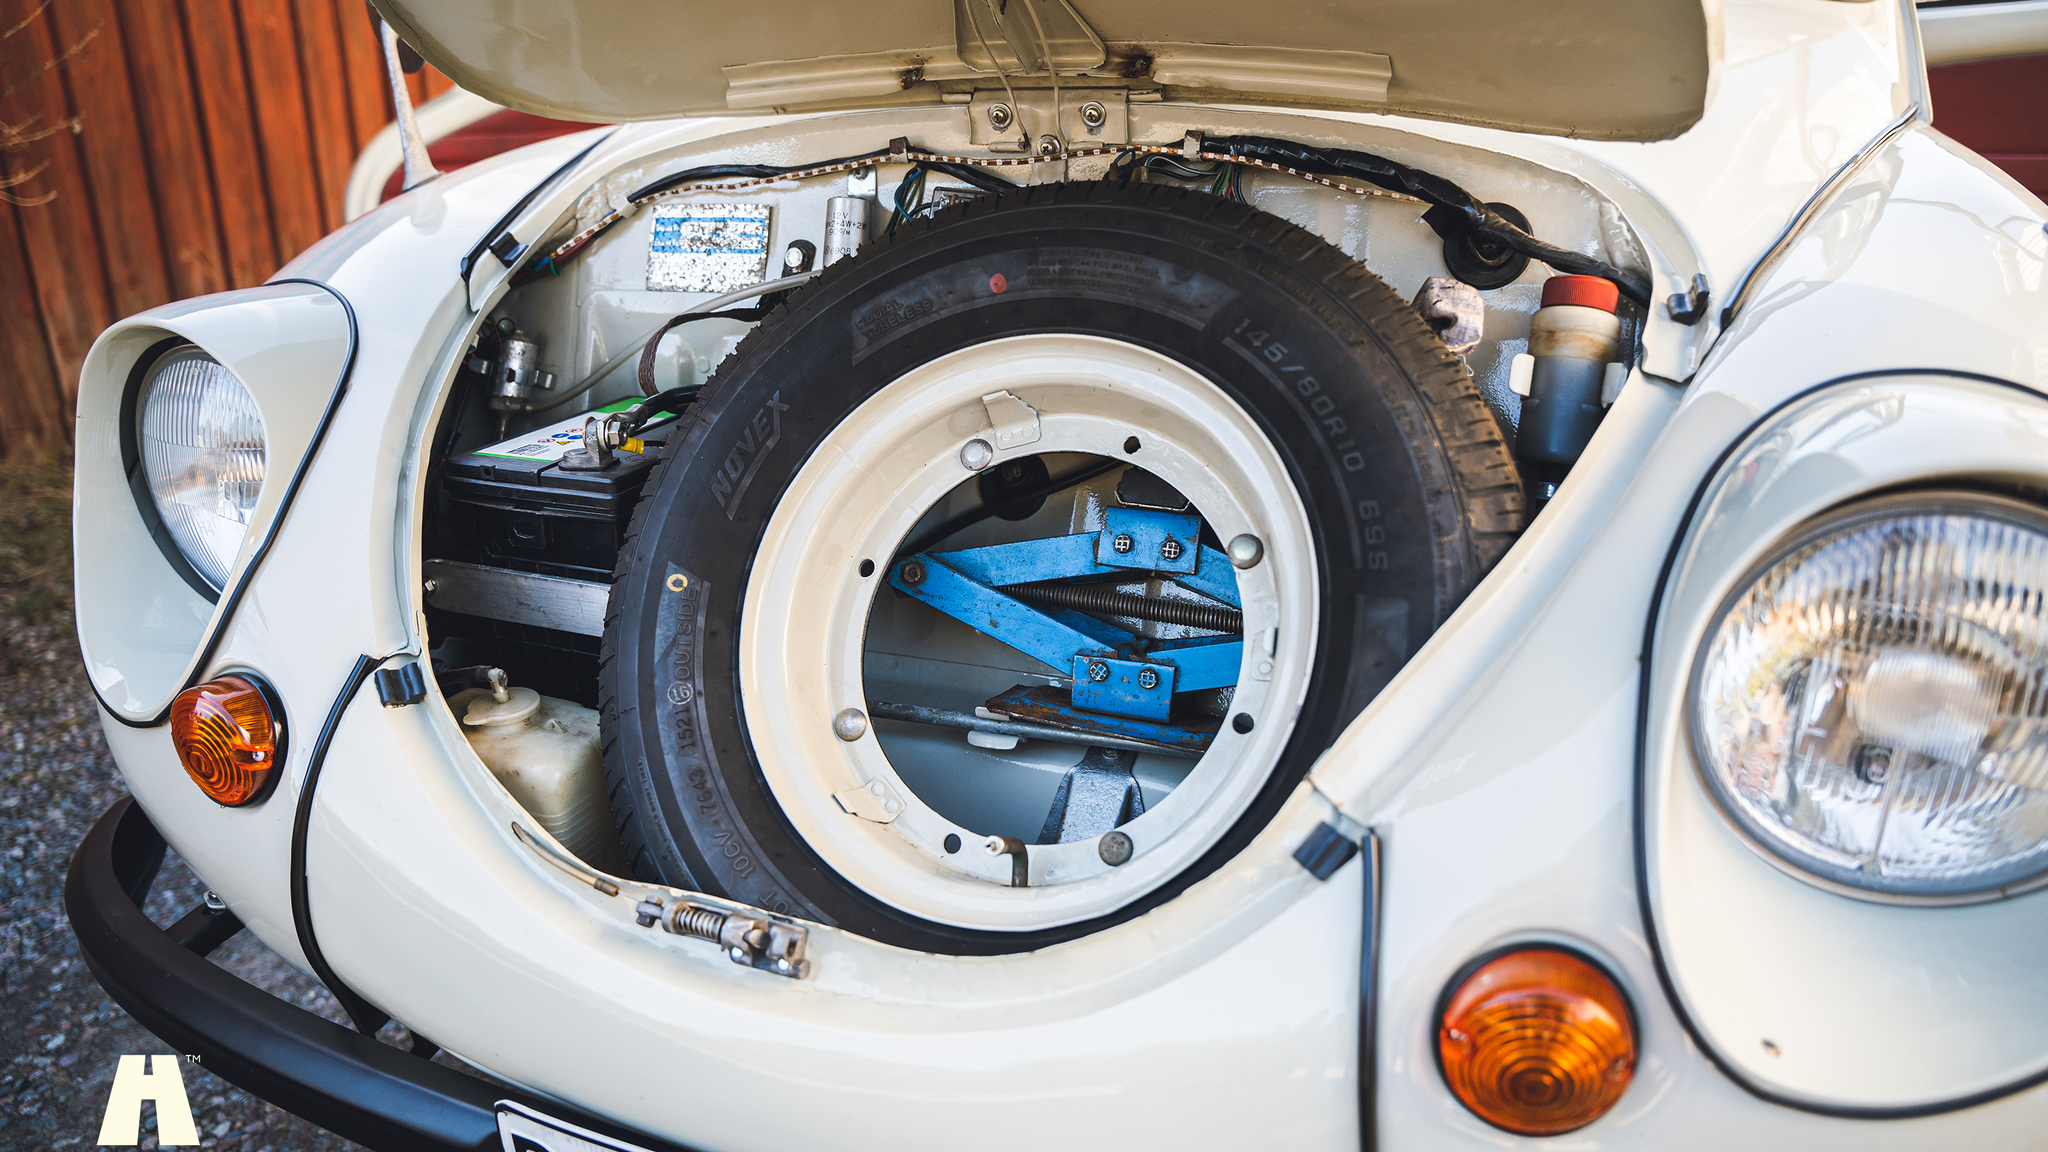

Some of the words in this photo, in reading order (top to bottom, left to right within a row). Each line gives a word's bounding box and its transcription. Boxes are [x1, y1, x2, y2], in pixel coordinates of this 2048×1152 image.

[856, 300, 903, 329] RADIAL
[862, 301, 933, 340] TUBELESS
[711, 390, 790, 508] NOVEX
[1234, 318, 1365, 473] 145/80R10
[1358, 500, 1388, 571] 69S
[674, 587, 698, 683] OUTSIDE
[676, 705, 695, 752] 1521
[688, 769, 716, 816] 7643
[714, 829, 754, 880] 10CV
